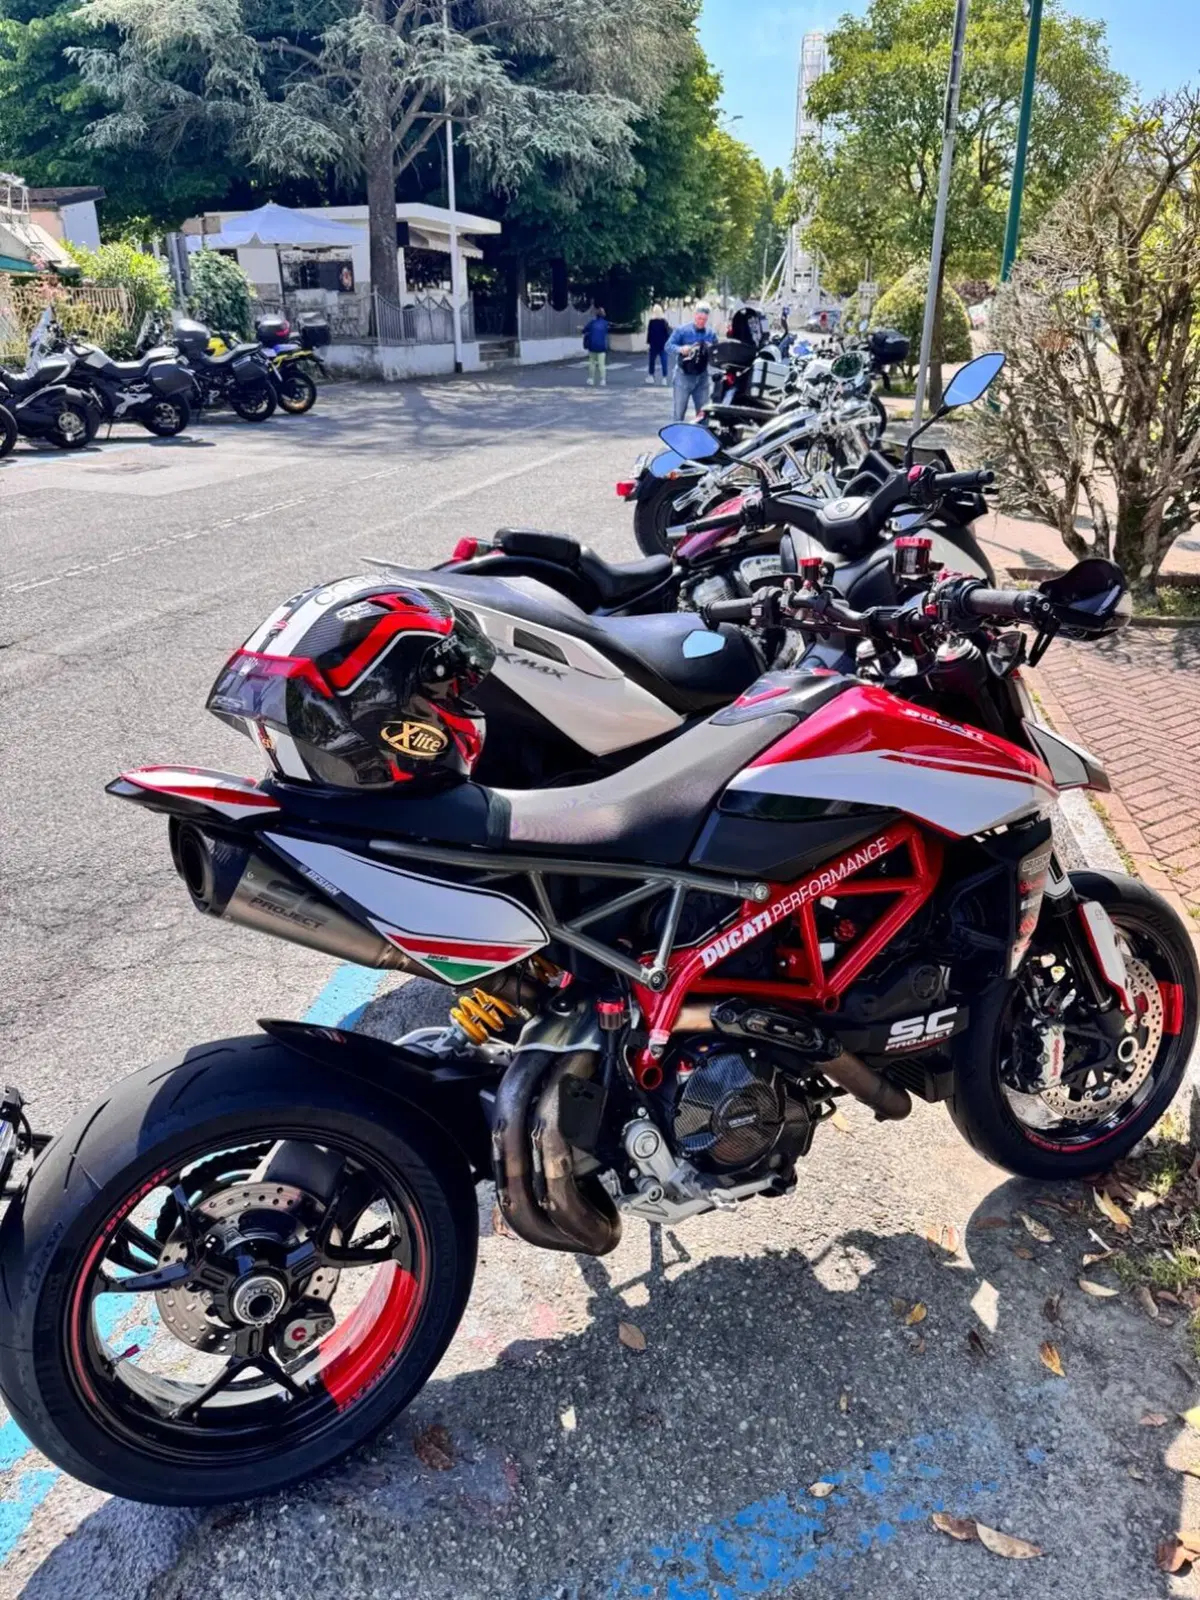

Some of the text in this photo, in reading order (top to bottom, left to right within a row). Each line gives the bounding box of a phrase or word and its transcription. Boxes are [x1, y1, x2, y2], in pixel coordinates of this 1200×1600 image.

[387, 720, 442, 751] X-lite
[905, 708, 984, 741] DUCATI
[249, 896, 325, 929] PROJECT
[700, 836, 889, 969] DUCATI PERFORMANCE
[887, 1006, 958, 1045] SC
